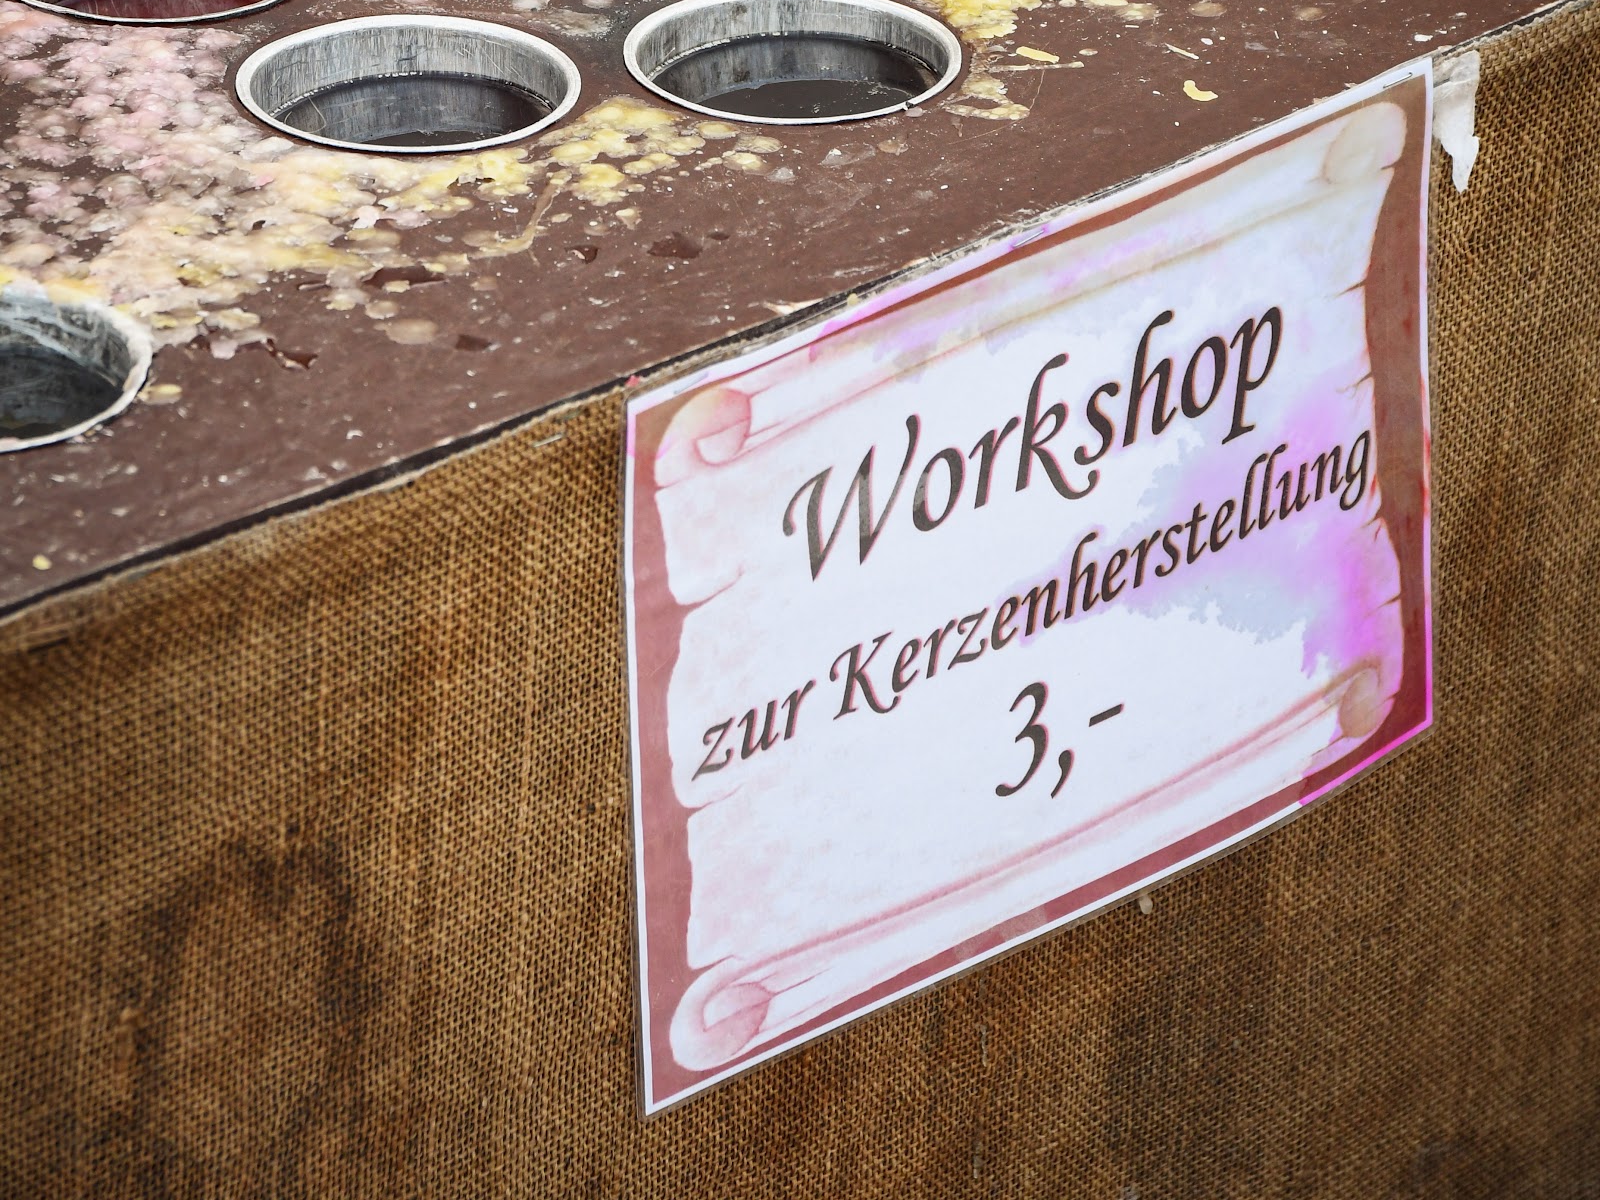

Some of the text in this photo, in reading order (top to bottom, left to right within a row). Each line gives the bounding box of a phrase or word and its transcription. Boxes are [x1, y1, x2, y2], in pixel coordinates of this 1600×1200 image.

[781, 305, 1284, 582] Workshop
[690, 428, 1374, 781] zur Kerzenherstellung
[994, 681, 1125, 800] 3,-
